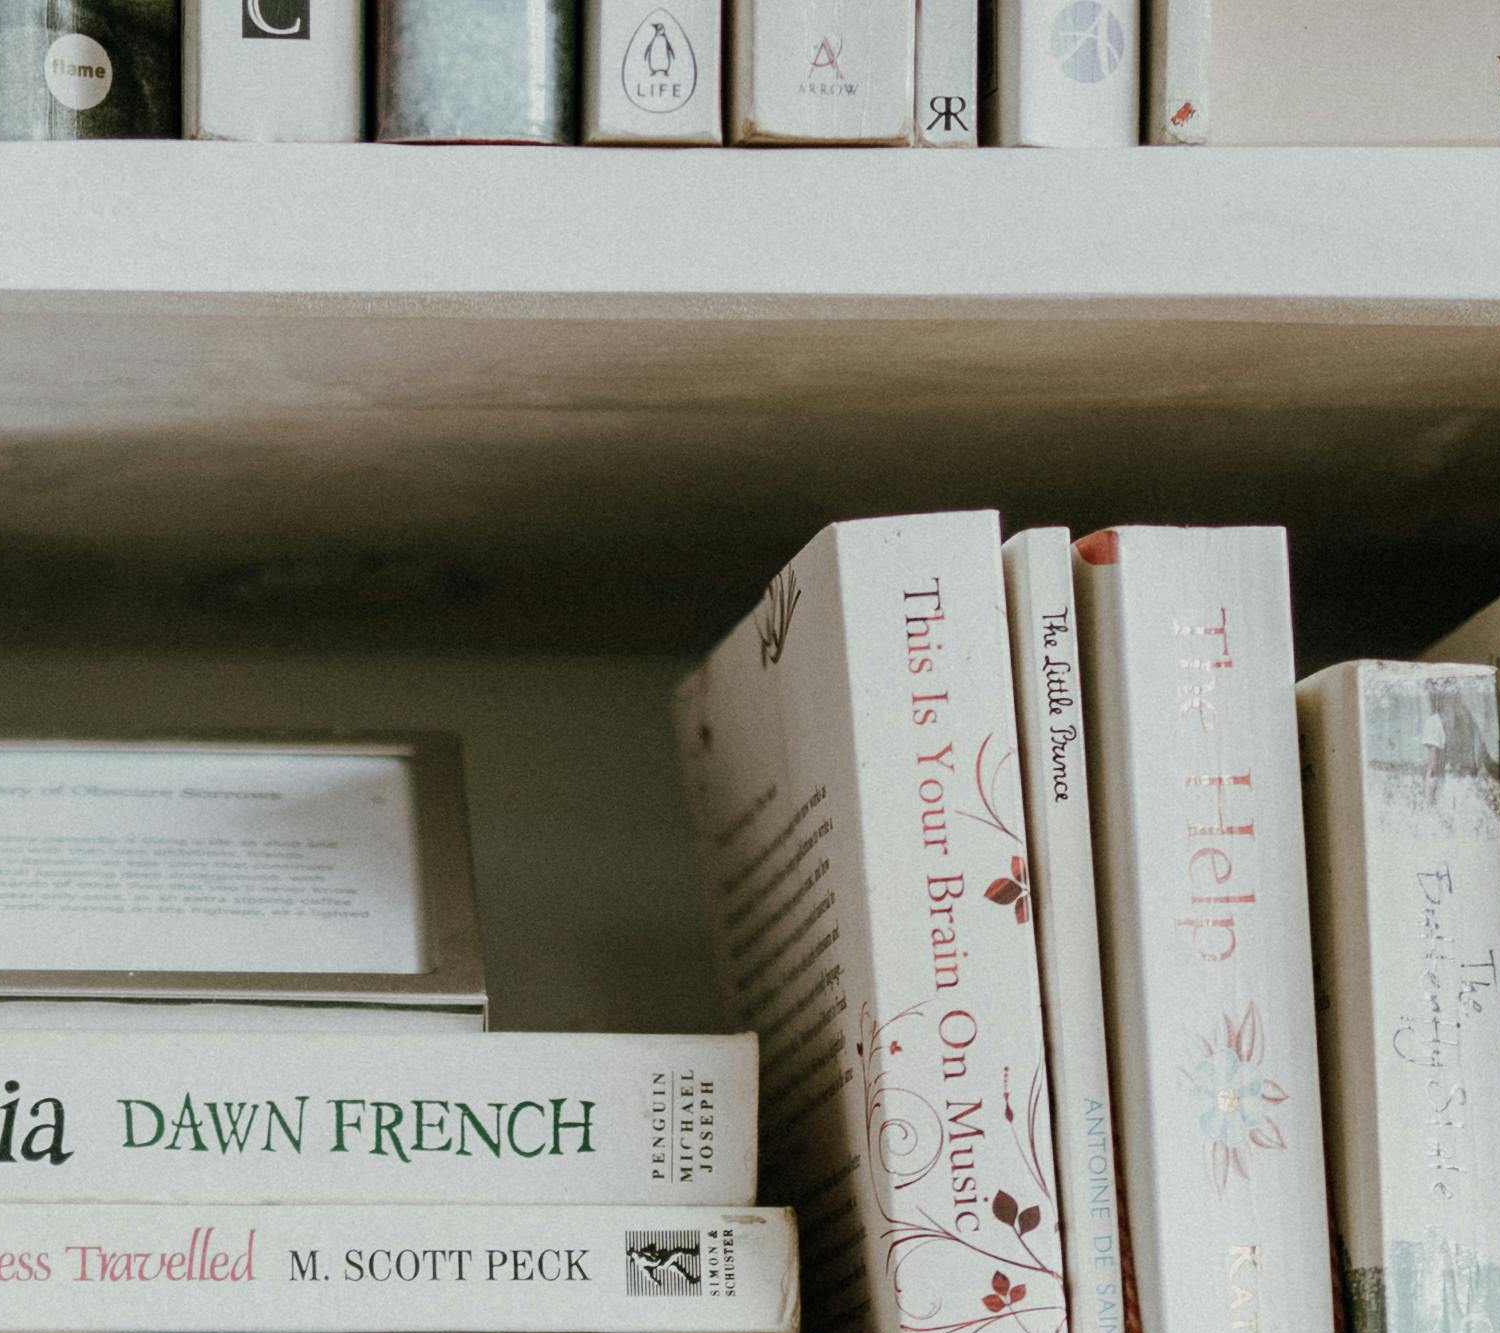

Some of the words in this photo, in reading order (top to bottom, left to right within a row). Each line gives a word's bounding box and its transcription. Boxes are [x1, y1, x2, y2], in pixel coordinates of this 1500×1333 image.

[635, 80, 683, 99] LIFE
[902, 577, 946, 674] This
[1041, 606, 1069, 649] The
[911, 690, 950, 726] Is
[1043, 653, 1072, 717] Little
[917, 741, 957, 856] Your
[1049, 723, 1077, 804] Prince
[926, 871, 969, 992] Brain
[938, 1008, 979, 1080] On
[117, 1092, 309, 1155] DAWN
[328, 1096, 597, 1163] FRENCH
[652, 1071, 667, 1180] PENGUIN
[679, 1069, 694, 1183] MICHAEL
[700, 1080, 714, 1173] JOSEPH
[946, 1098, 985, 1235] Music
[65, 1227, 256, 1283] Travelled
[289, 1250, 329, 1281] M.
[344, 1249, 472, 1282] SCOTT
[486, 1249, 592, 1282] PECK
[708, 1229, 720, 1239] &
[710, 1243, 720, 1296] SIMON
[725, 1228, 735, 1297] SCHUSTER
